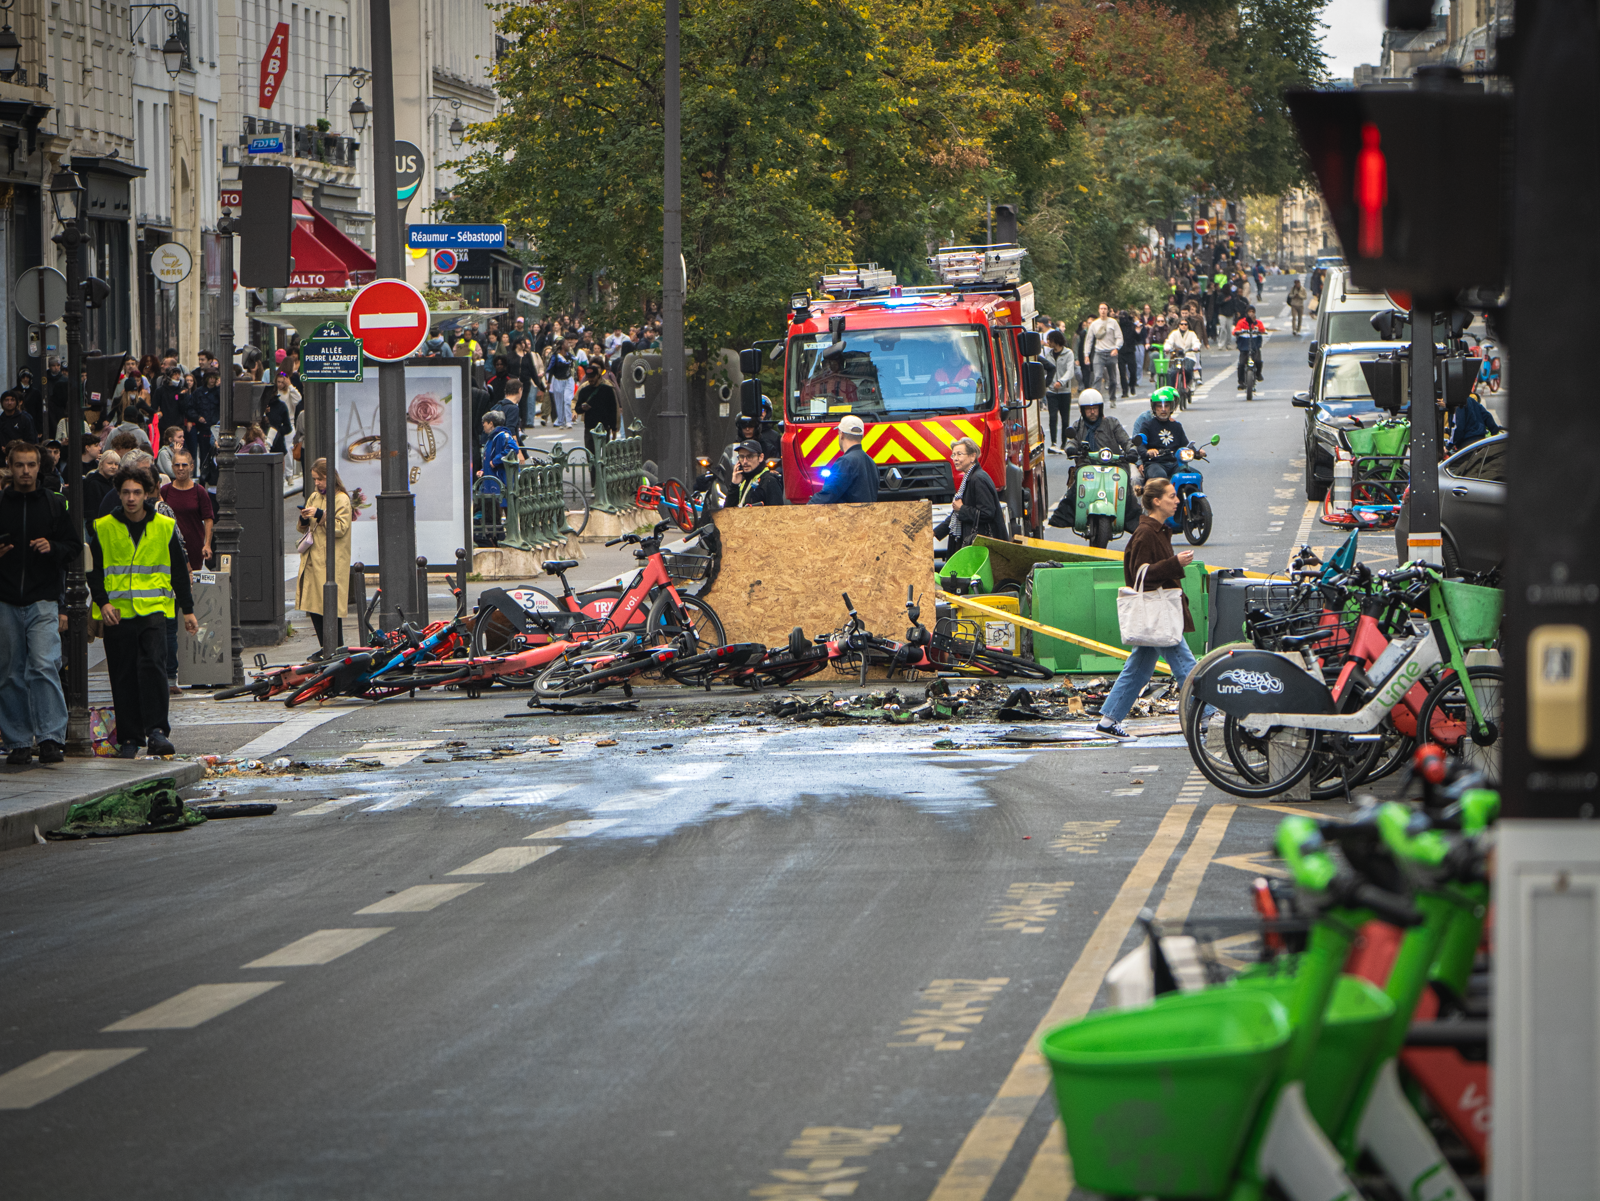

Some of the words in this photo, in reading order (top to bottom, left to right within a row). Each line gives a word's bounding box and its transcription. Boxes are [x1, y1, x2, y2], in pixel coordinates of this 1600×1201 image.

[264, 34, 285, 97] TABAC
[253, 140, 269, 148] FDJ
[220, 194, 240, 204] TO
[411, 231, 448, 242] Réaumur
[457, 231, 503, 244] Sébastopol
[321, 346, 342, 354] ALLÉE
[523, 593, 535, 609] 3
[594, 602, 614, 613] TRY
